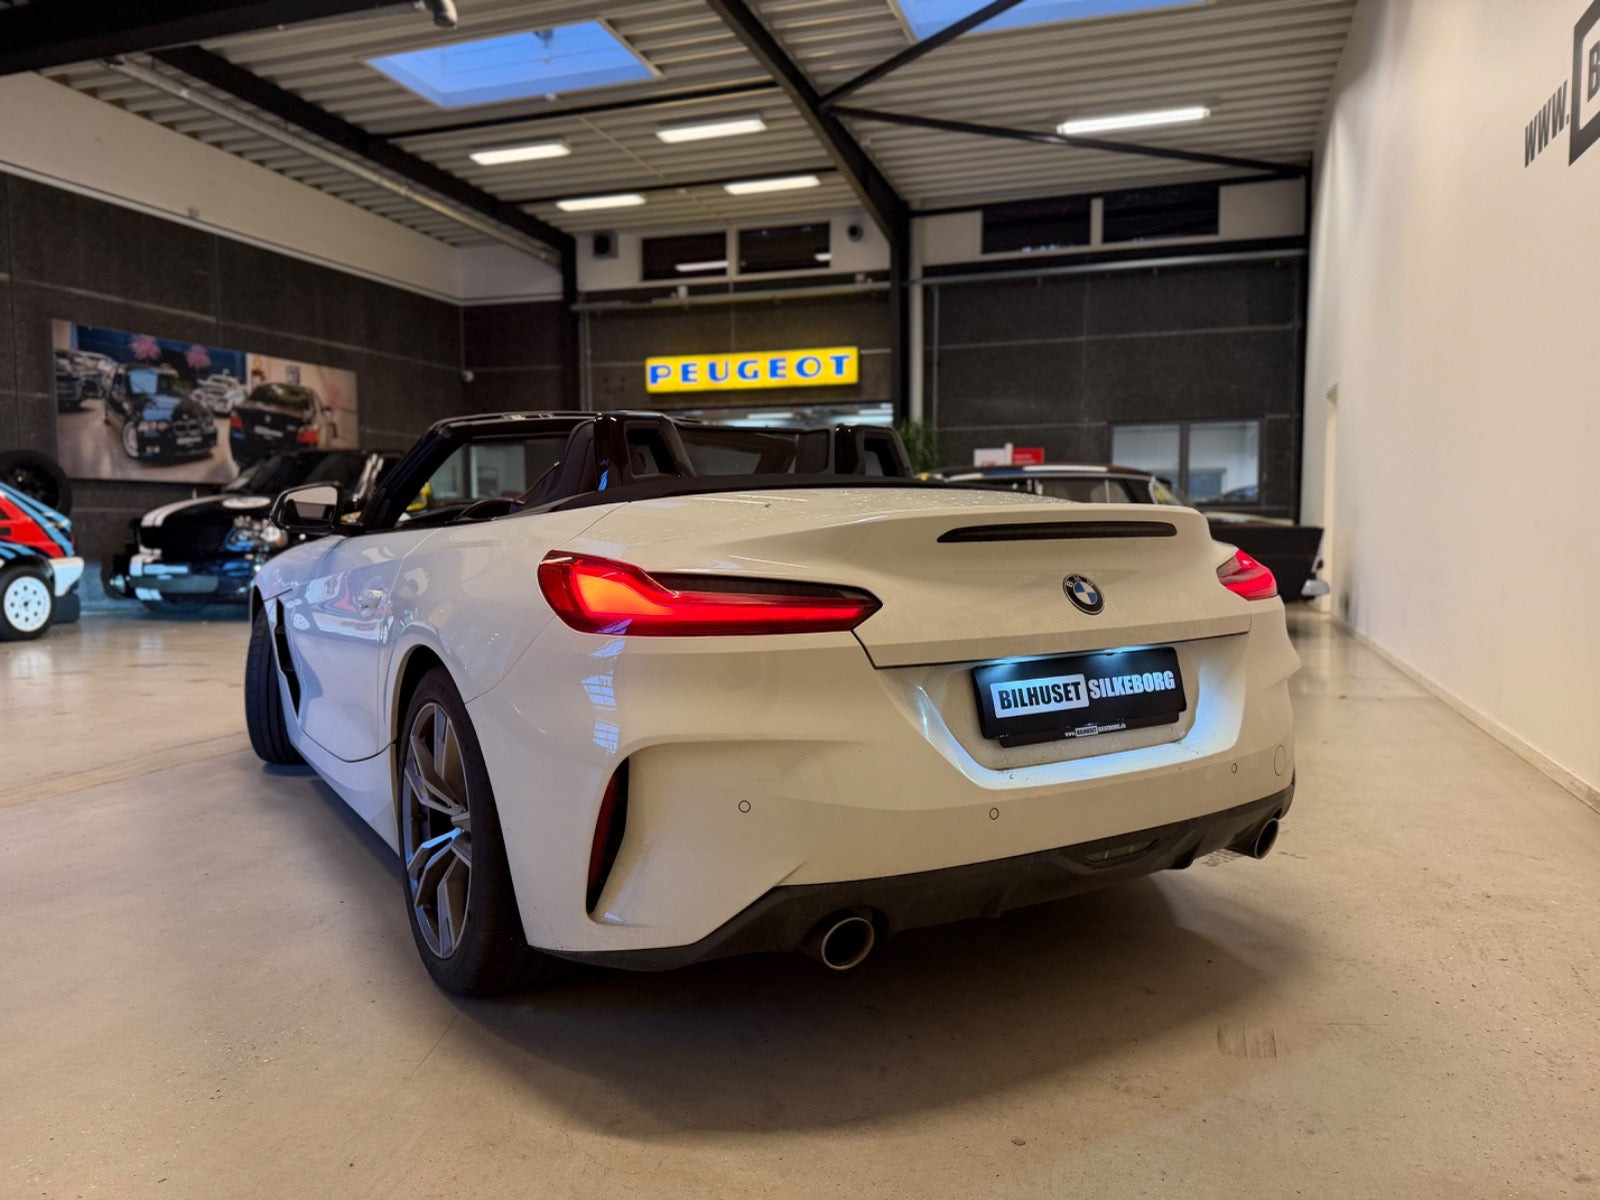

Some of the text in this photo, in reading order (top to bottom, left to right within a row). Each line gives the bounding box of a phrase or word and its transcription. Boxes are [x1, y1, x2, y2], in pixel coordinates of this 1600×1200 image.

[1525, 79, 1570, 168] WWW.
[649, 354, 851, 385] PEUGEOT
[999, 670, 1176, 711] BILHUSET SILKEBORG
